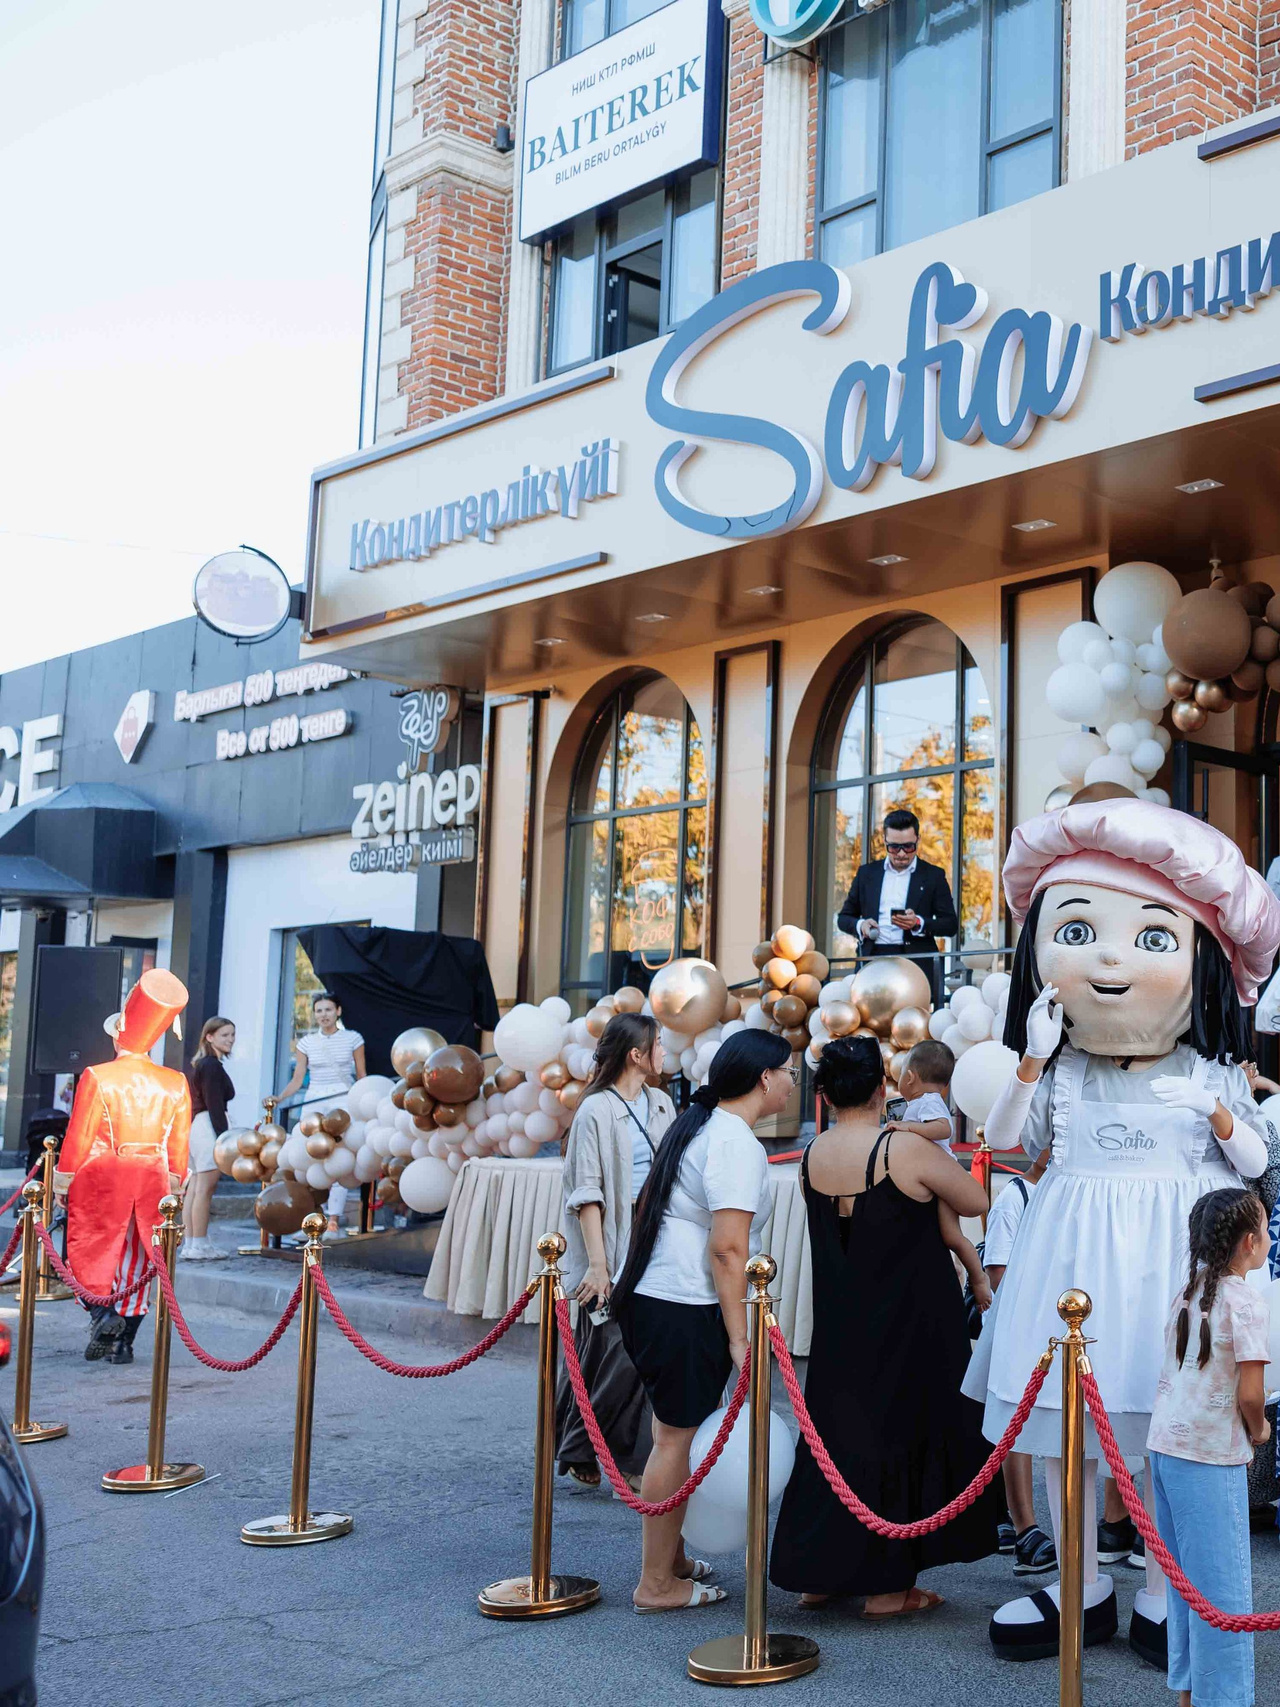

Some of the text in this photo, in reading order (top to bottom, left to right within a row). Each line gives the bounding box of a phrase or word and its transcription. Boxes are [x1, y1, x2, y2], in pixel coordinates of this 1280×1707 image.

[572, 43, 656, 96] НИШ КТЛ РФМШ
[526, 55, 702, 175] BAITEREK
[555, 162, 581, 184] BILIM
[584, 151, 610, 171] BERU
[645, 260, 1093, 538] Safia
[245, 670, 273, 707] 500
[216, 708, 347, 760] Все от 500 тенге
[351, 761, 481, 839] zeinep
[350, 830, 464, 873] әйелдер киімі
[1096, 1123, 1158, 1151] Safia
